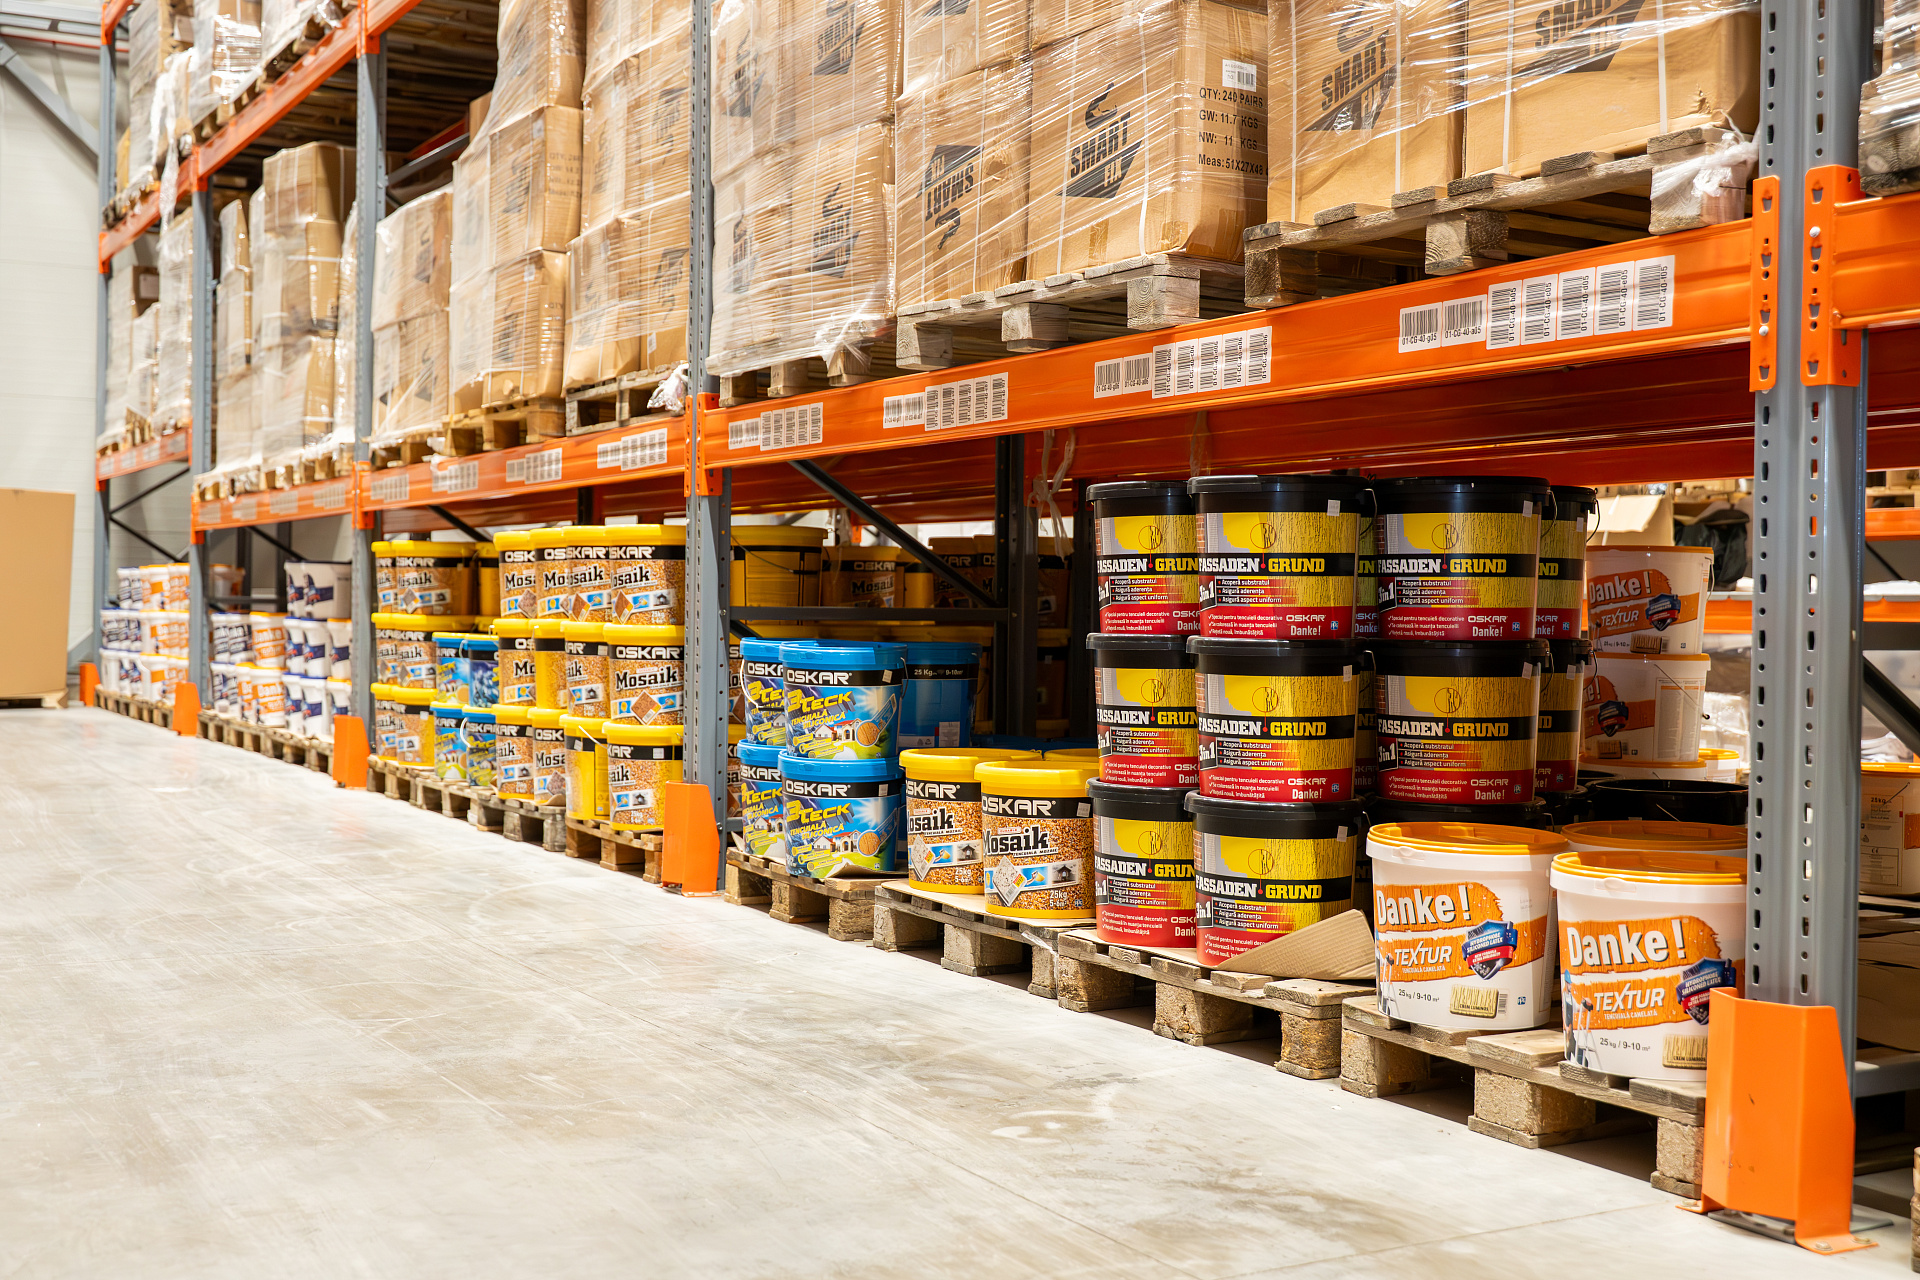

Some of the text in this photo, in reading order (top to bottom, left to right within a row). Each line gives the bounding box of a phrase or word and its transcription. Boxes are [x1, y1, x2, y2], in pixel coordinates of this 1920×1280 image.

[1321, 29, 1389, 111] SMART
[1199, 87, 1263, 109] QTY: 240 PAIRS
[1199, 109, 1259, 129] GW: 11.7 KGS
[1070, 111, 1131, 178] SMART
[1198, 131, 1258, 150] NW: 11 KGS
[1104, 156, 1123, 187] FIX
[925, 162, 973, 222] SMART
[505, 551, 535, 562] OSK
[568, 547, 606, 559] SKAR
[610, 547, 652, 559] SKAR
[1155, 557, 1198, 572] GRUN
[1199, 557, 1325, 573] FASSADEN GRUND
[1378, 558, 1507, 574] FASSADEN GRUND
[1286, 614, 1325, 622] OSKAR
[1467, 615, 1507, 623] OSKAR
[1177, 620, 1200, 631] Danke
[1290, 624, 1321, 636] Danke!
[1472, 625, 1503, 637] Danke!
[616, 646, 680, 660] OSKAR
[747, 662, 783, 676] OSK
[616, 665, 678, 691] Mosaik
[787, 670, 850, 685] OSKAR
[1157, 711, 1198, 725] GRUN
[1199, 717, 1326, 736] FASSADEN GRUND
[1378, 718, 1508, 737] FASSADEN GRUND
[535, 729, 563, 740] OSK
[1378, 743, 1396, 762] 3in1
[1174, 763, 1198, 771] OSK
[1241, 759, 1260, 767] aspect
[741, 766, 782, 780] SKAR
[1178, 774, 1199, 784] Dank
[785, 780, 848, 796] OSKAR
[1287, 777, 1326, 786] OSKAR
[1470, 779, 1509, 787] OSKAR
[1292, 788, 1323, 800] Danke!
[1474, 789, 1505, 800] Danke!
[982, 796, 1052, 816] OSKAR
[908, 807, 954, 833] osaik
[983, 826, 1049, 855] Mosaik
[1154, 864, 1195, 878] GRUN
[1049, 890, 1068, 899] 25kg
[1196, 875, 1322, 900] FASSADEN GRUND
[1196, 901, 1211, 919] 3in1
[1238, 903, 1267, 911] substratul
[1170, 916, 1196, 924] OSK
[1237, 921, 1255, 929] aspect
[1255, 922, 1279, 930] uniform
[1174, 927, 1196, 936] Dank
[1566, 918, 1686, 967] Danke!
[1394, 941, 1452, 967] TEXTUR
[1398, 988, 1406, 997] 25
[1416, 992, 1432, 1002] 9-10
[1593, 983, 1665, 1012] TEXTUR
[1599, 1037, 1609, 1046] 25
[1622, 1041, 1641, 1051] 9-10
